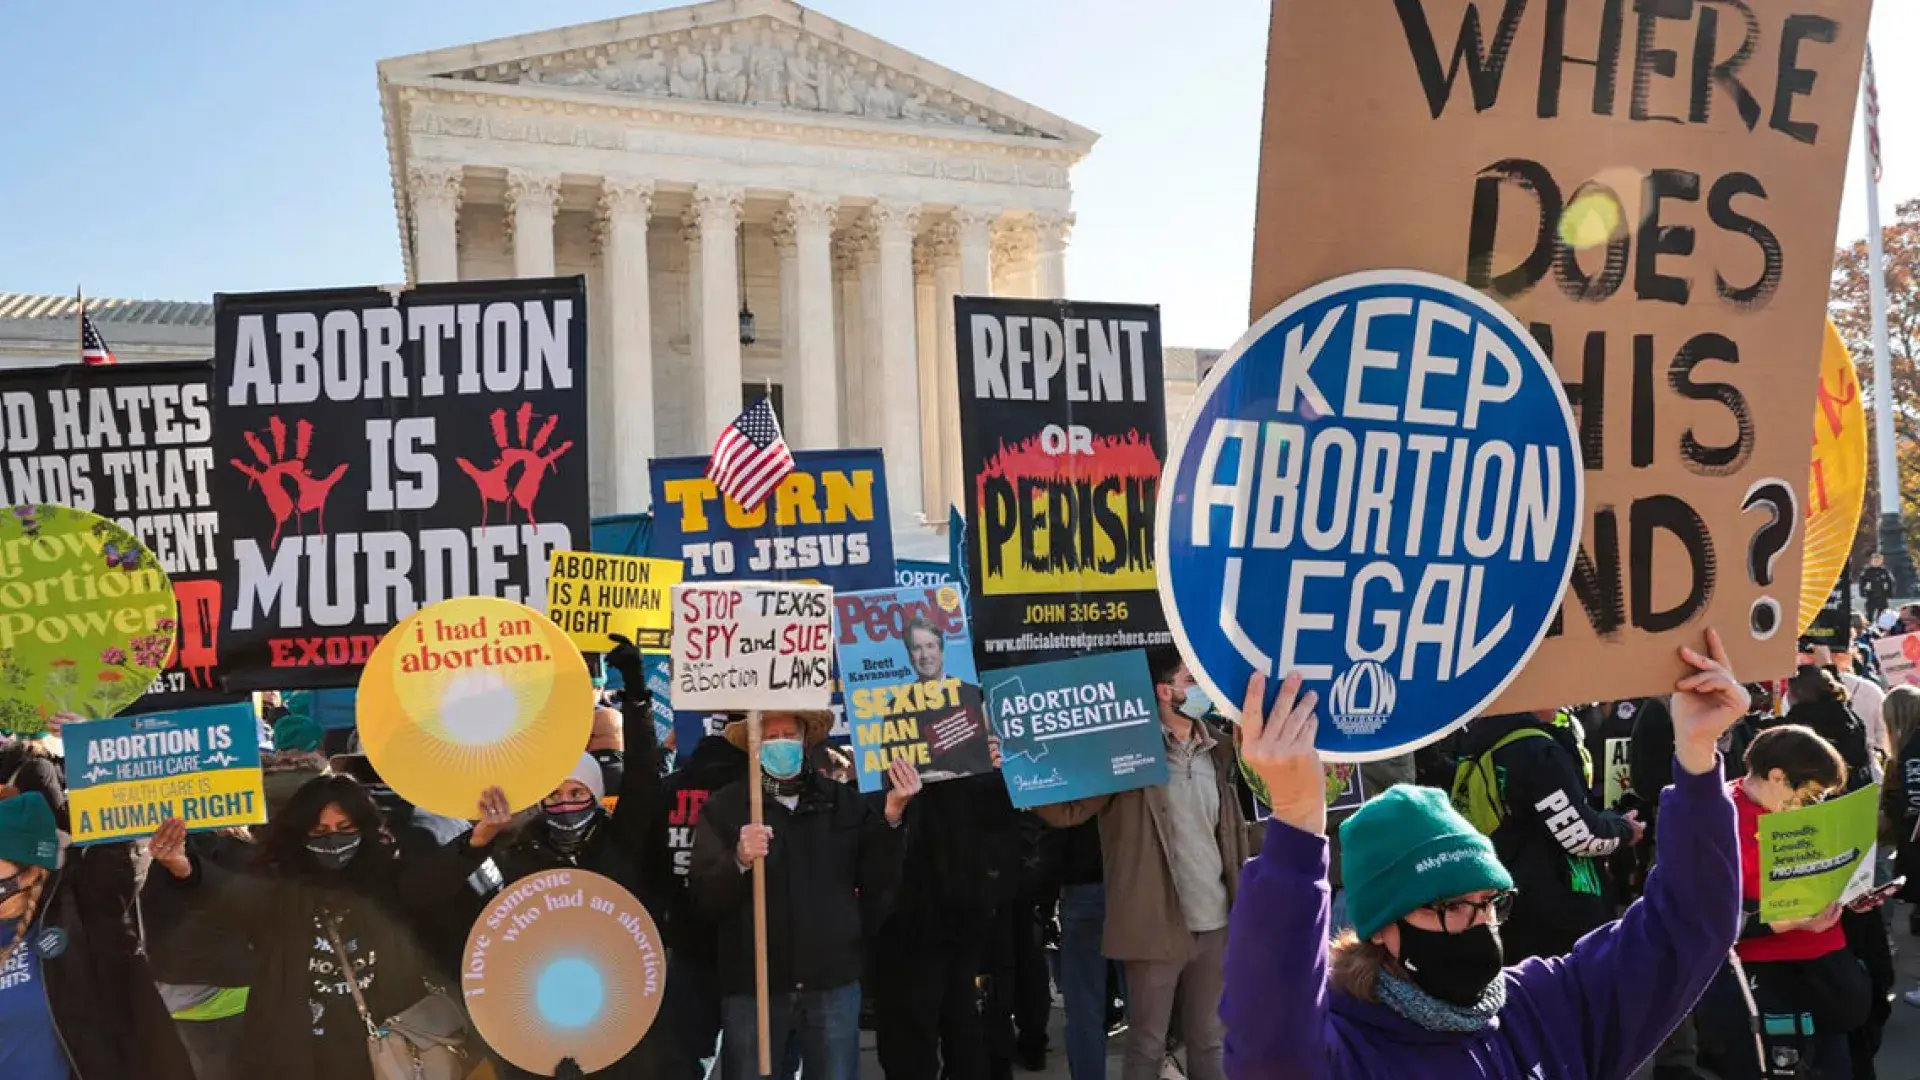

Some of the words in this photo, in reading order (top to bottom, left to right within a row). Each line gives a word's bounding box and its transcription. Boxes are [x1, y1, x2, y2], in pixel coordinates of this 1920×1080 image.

[1393, 0, 1841, 144] WHERE
[1466, 158, 1783, 310] DOES
[228, 300, 573, 405] ABORTION
[971, 313, 1149, 402] REPENT
[1278, 297, 1523, 430] KEEP
[0, 391, 38, 452] D
[48, 382, 211, 450] HATES
[1530, 322, 1754, 477] HIS
[1041, 424, 1095, 455] OR
[102, 447, 214, 511] THAT
[365, 417, 439, 511] IS
[1192, 417, 1561, 562] ABORTION
[115, 511, 219, 575] CENT
[984, 475, 1157, 579] PERISH
[0, 530, 109, 578] row
[552, 555, 650, 584] ABORTION
[682, 541, 735, 576] TO
[749, 533, 870, 571] JESUS
[1545, 494, 1717, 640] ND
[0, 563, 161, 609] ortion
[552, 582, 572, 605] IS
[578, 584, 590, 606] A
[599, 585, 661, 610] HUMAN
[681, 588, 742, 623] STOP
[757, 590, 827, 616] TEXAS
[415, 621, 424, 643] i
[436, 616, 487, 643] had
[499, 618, 532, 637] an
[551, 608, 612, 634] RIGHT
[1023, 604, 1065, 624] JOHN
[1070, 602, 1128, 623] 3:16-36
[1219, 557, 1514, 681] LEGAL
[268, 635, 386, 668] EXOD
[401, 640, 551, 673] abortion.
[686, 623, 739, 660] SPY
[740, 628, 775, 654] and
[779, 623, 829, 656] SUE
[681, 666, 758, 692] abortion
[769, 655, 827, 690] LAWS
[848, 666, 912, 683] Kavanaugh
[862, 657, 894, 671] Brett
[852, 677, 962, 719] SEXIST
[1001, 680, 1116, 718] ABORTION
[1329, 661, 1396, 714] NOW
[857, 717, 920, 746] MAN
[1003, 717, 1025, 739] IS
[1031, 698, 1150, 735] ESSENTIAL
[87, 728, 200, 764] ABORTION
[207, 724, 232, 750] IS
[864, 742, 932, 773] ALIVE
[116, 760, 163, 780] HEALTH
[166, 755, 200, 776] CARE
[111, 783, 159, 803] HEALTH
[160, 778, 194, 800] CARE
[198, 776, 212, 794] IS
[79, 811, 93, 833] A
[99, 800, 175, 831] HUMAN
[182, 790, 255, 822] RIGHT
[464, 934, 491, 980] love
[486, 871, 572, 929] someone
[502, 907, 541, 942] who
[543, 888, 584, 911] had
[590, 895, 615, 915] an
[617, 911, 661, 997] abortion.
